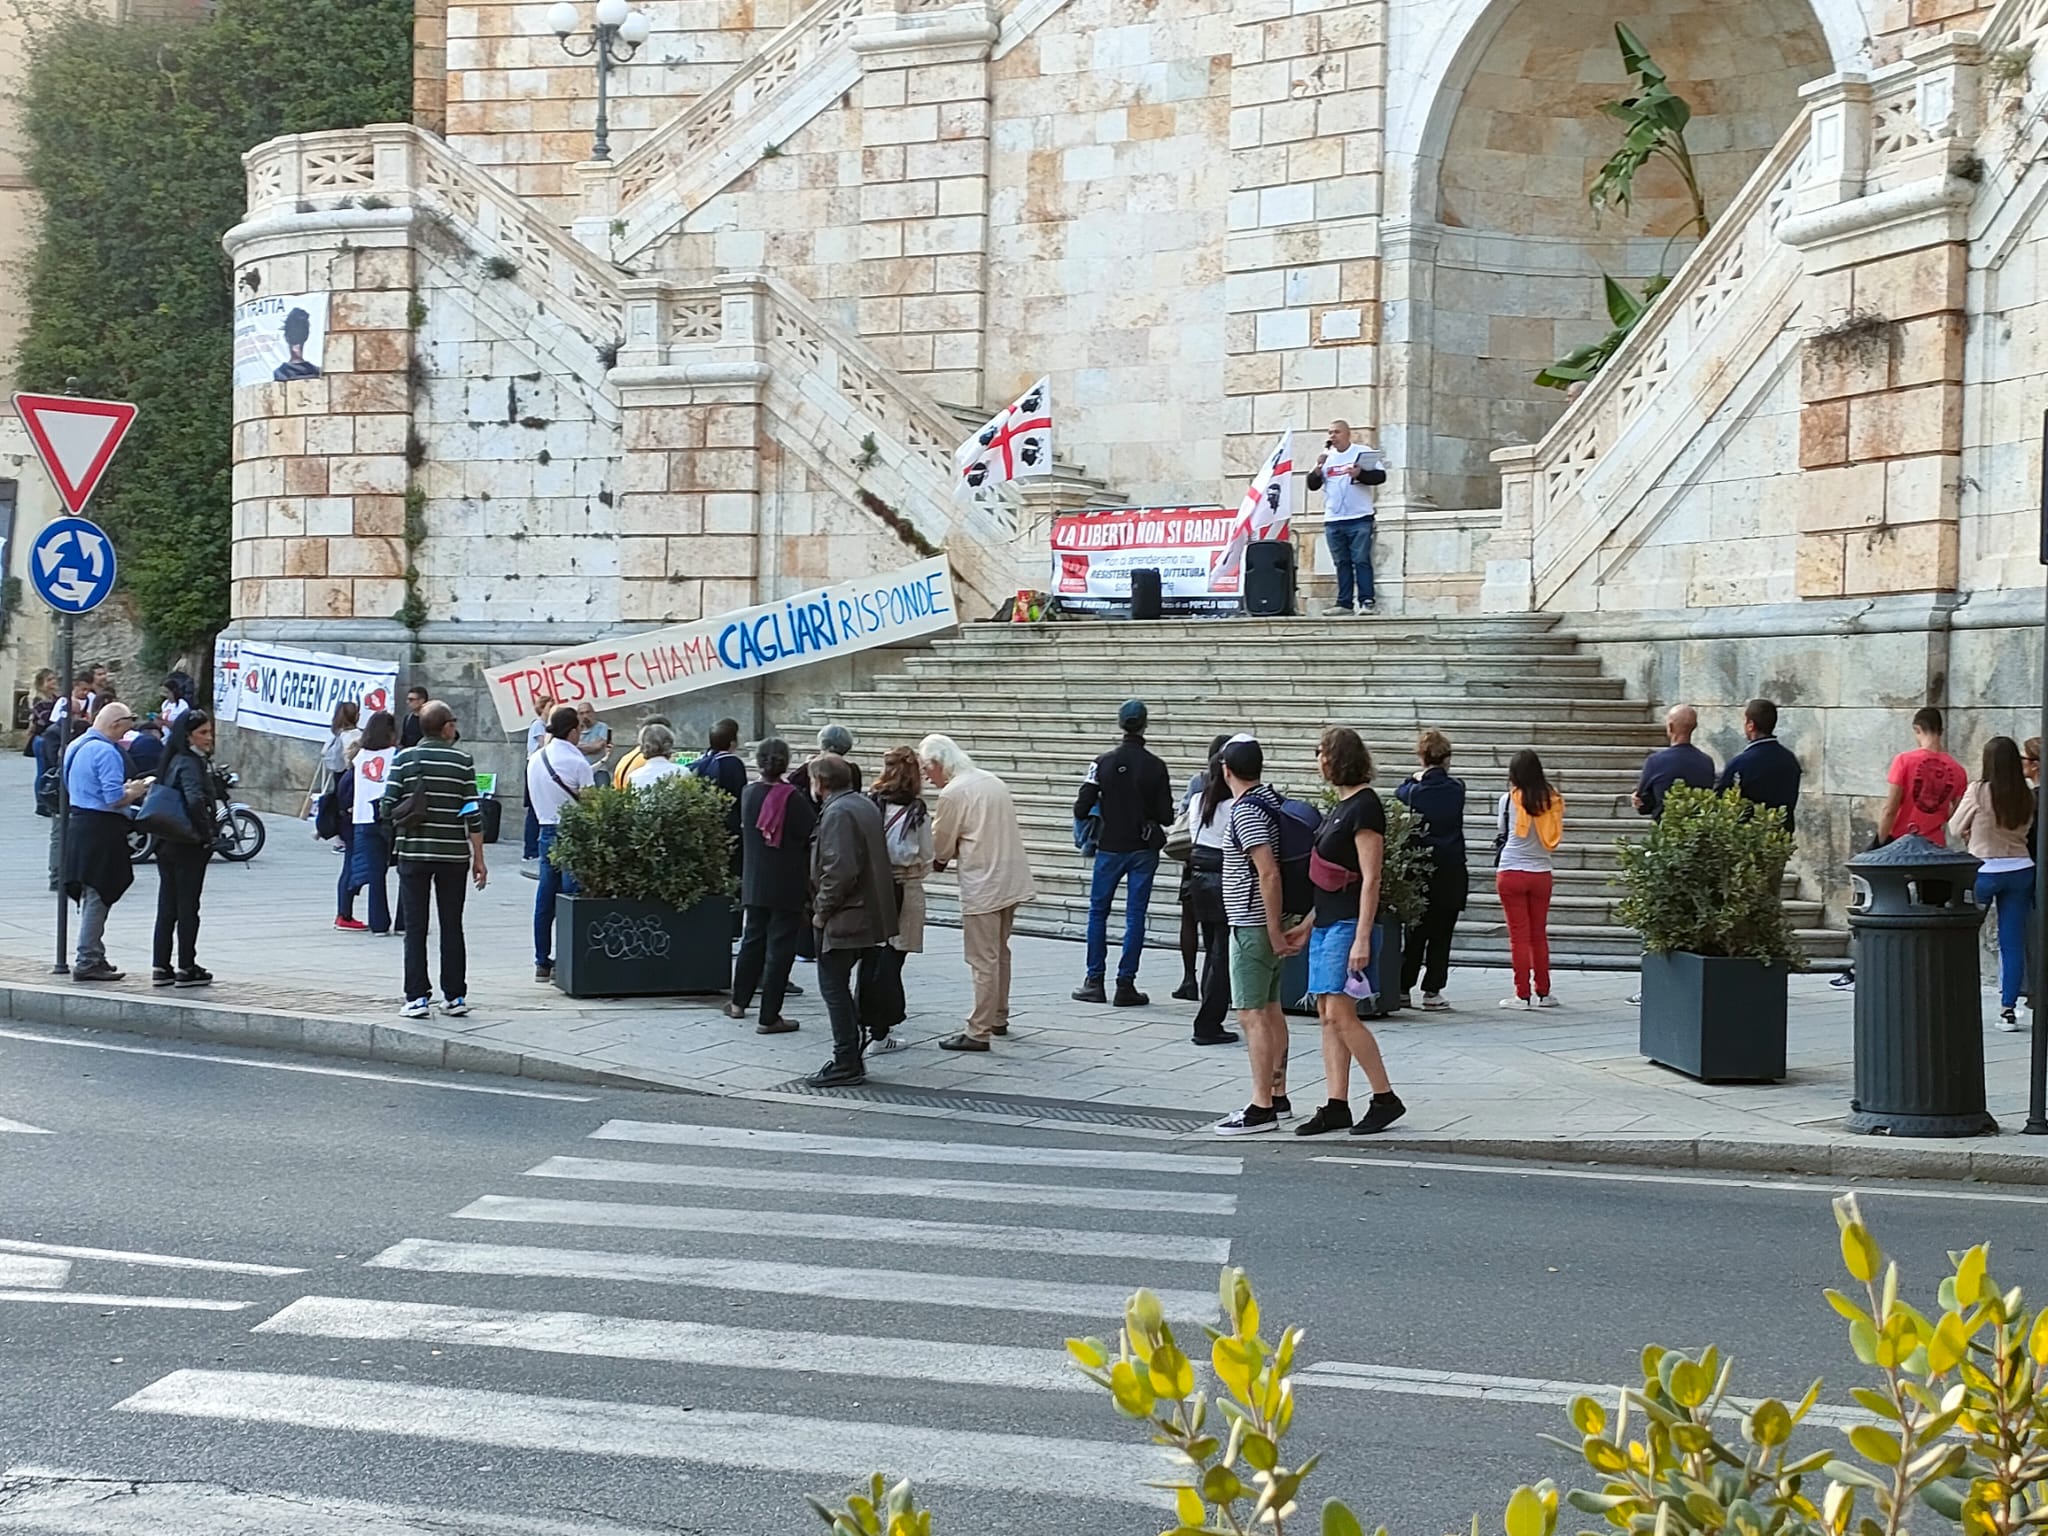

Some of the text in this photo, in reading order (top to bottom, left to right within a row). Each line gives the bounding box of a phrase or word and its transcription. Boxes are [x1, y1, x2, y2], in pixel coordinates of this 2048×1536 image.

[1056, 517, 1236, 547] LA LIBERTÀ NON SI BARATT
[498, 571, 950, 717] TRIESTE CHIAMA CAGLIARI RISPONDE
[261, 666, 278, 703] NO
[280, 669, 327, 712] GREEN
[325, 678, 365, 713] PASS
